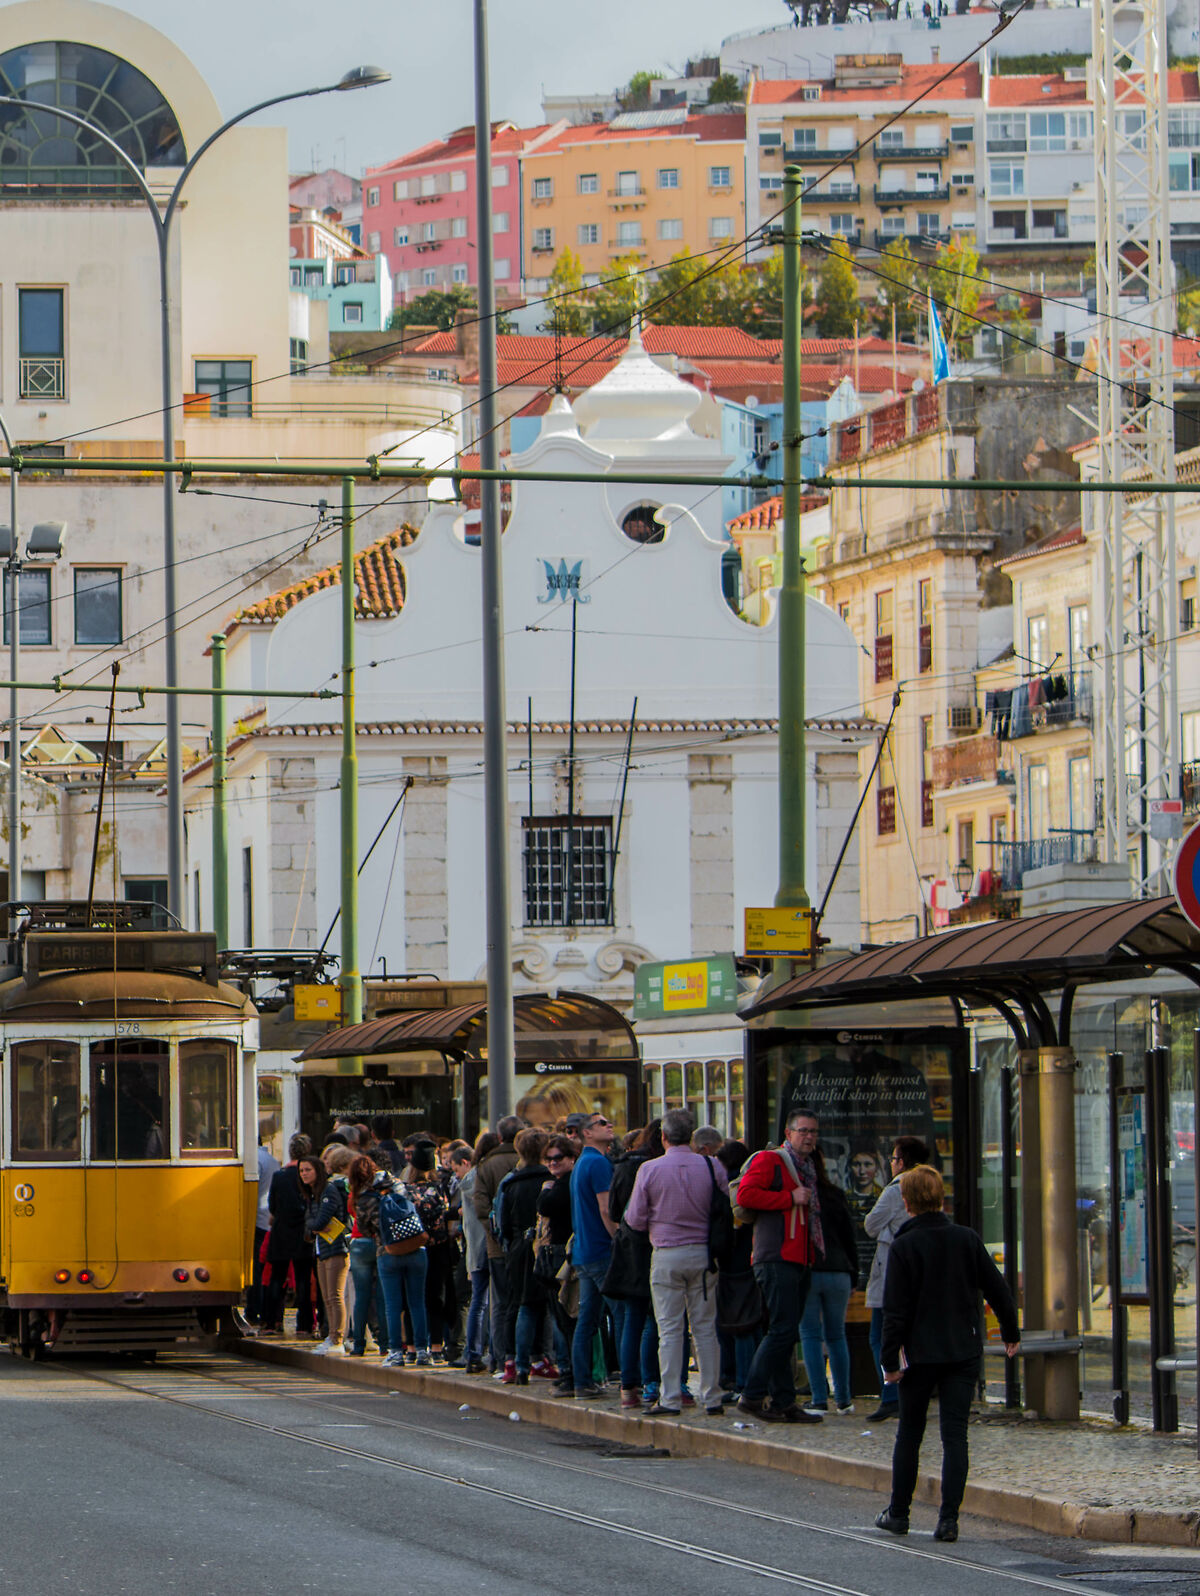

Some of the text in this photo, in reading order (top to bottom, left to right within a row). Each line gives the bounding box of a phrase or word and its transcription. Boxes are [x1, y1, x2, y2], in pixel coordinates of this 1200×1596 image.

[118, 1022, 140, 1034] 578
[799, 1072, 921, 1086] Welcome to the most
[791, 1087, 927, 1105] beautiful shop in town
